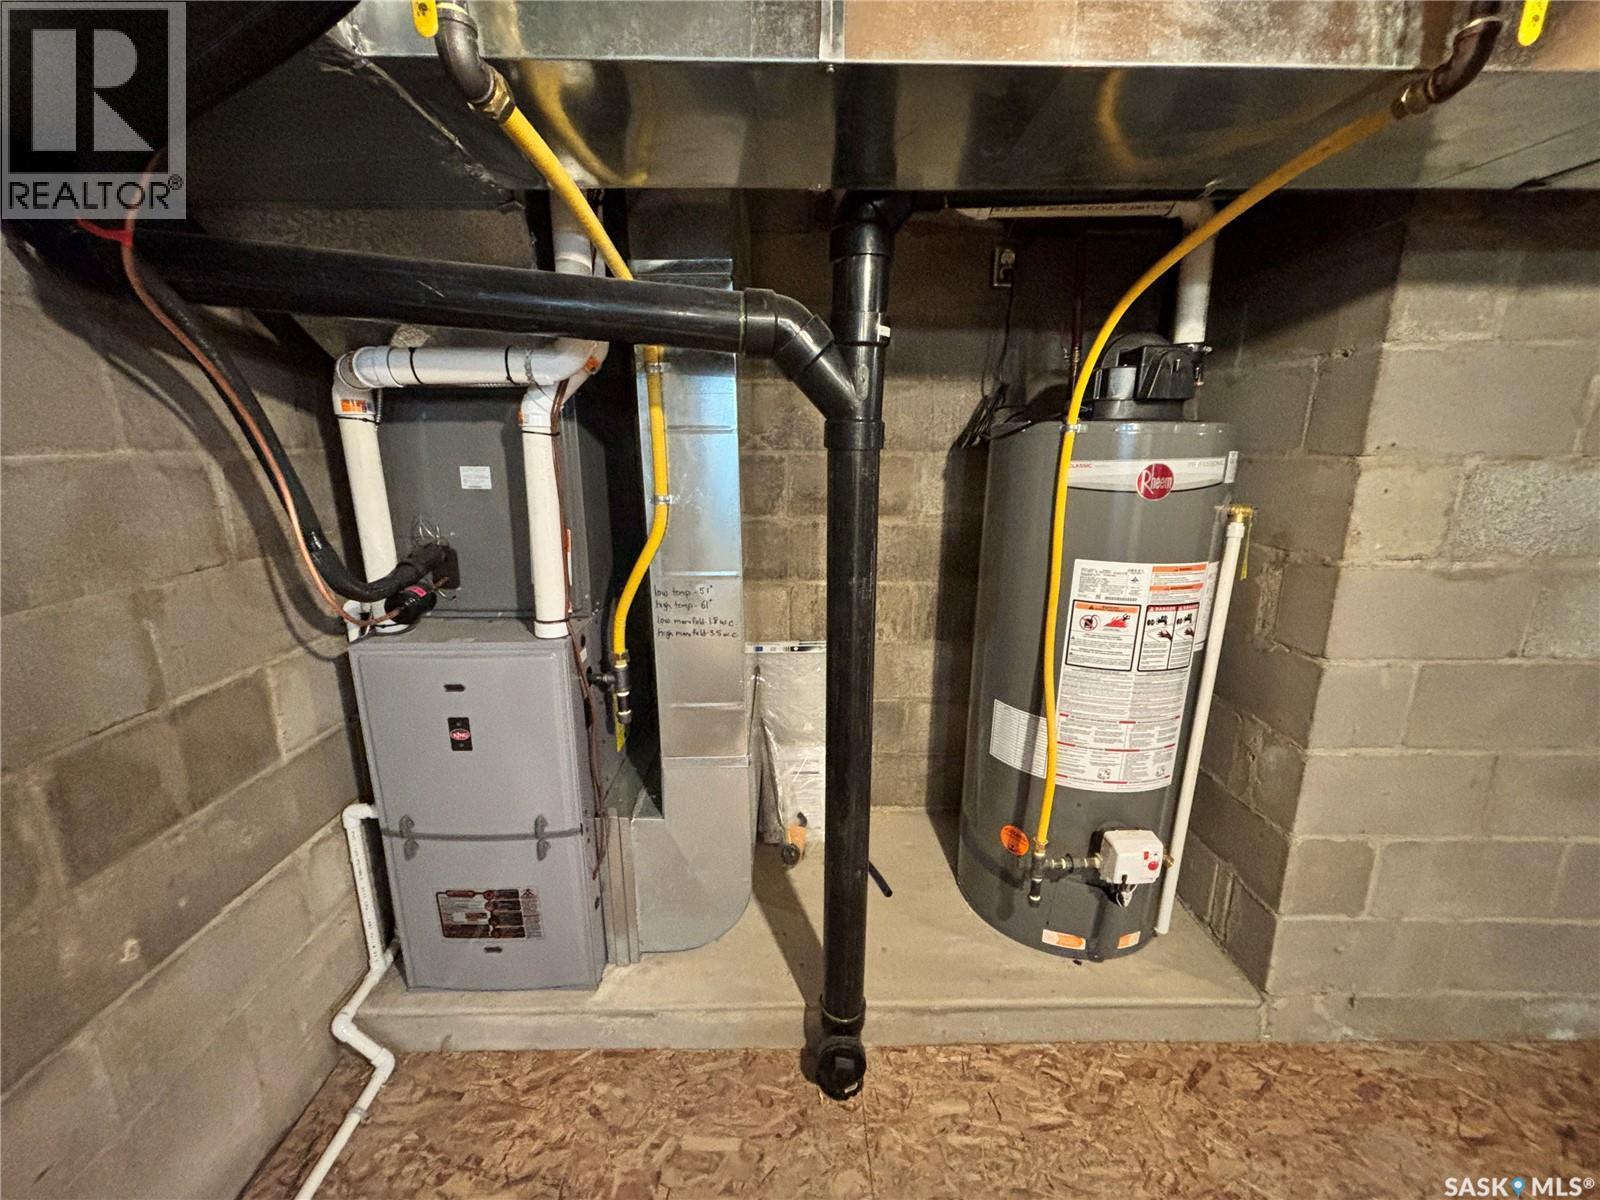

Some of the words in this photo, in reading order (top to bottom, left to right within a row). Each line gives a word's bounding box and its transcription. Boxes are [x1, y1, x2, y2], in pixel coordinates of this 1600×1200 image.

[1140, 464, 1172, 494] Rheem
[654, 584, 668, 597] low
[655, 599, 672, 611] high
[657, 616, 671, 625] low
[657, 628, 673, 639] high
